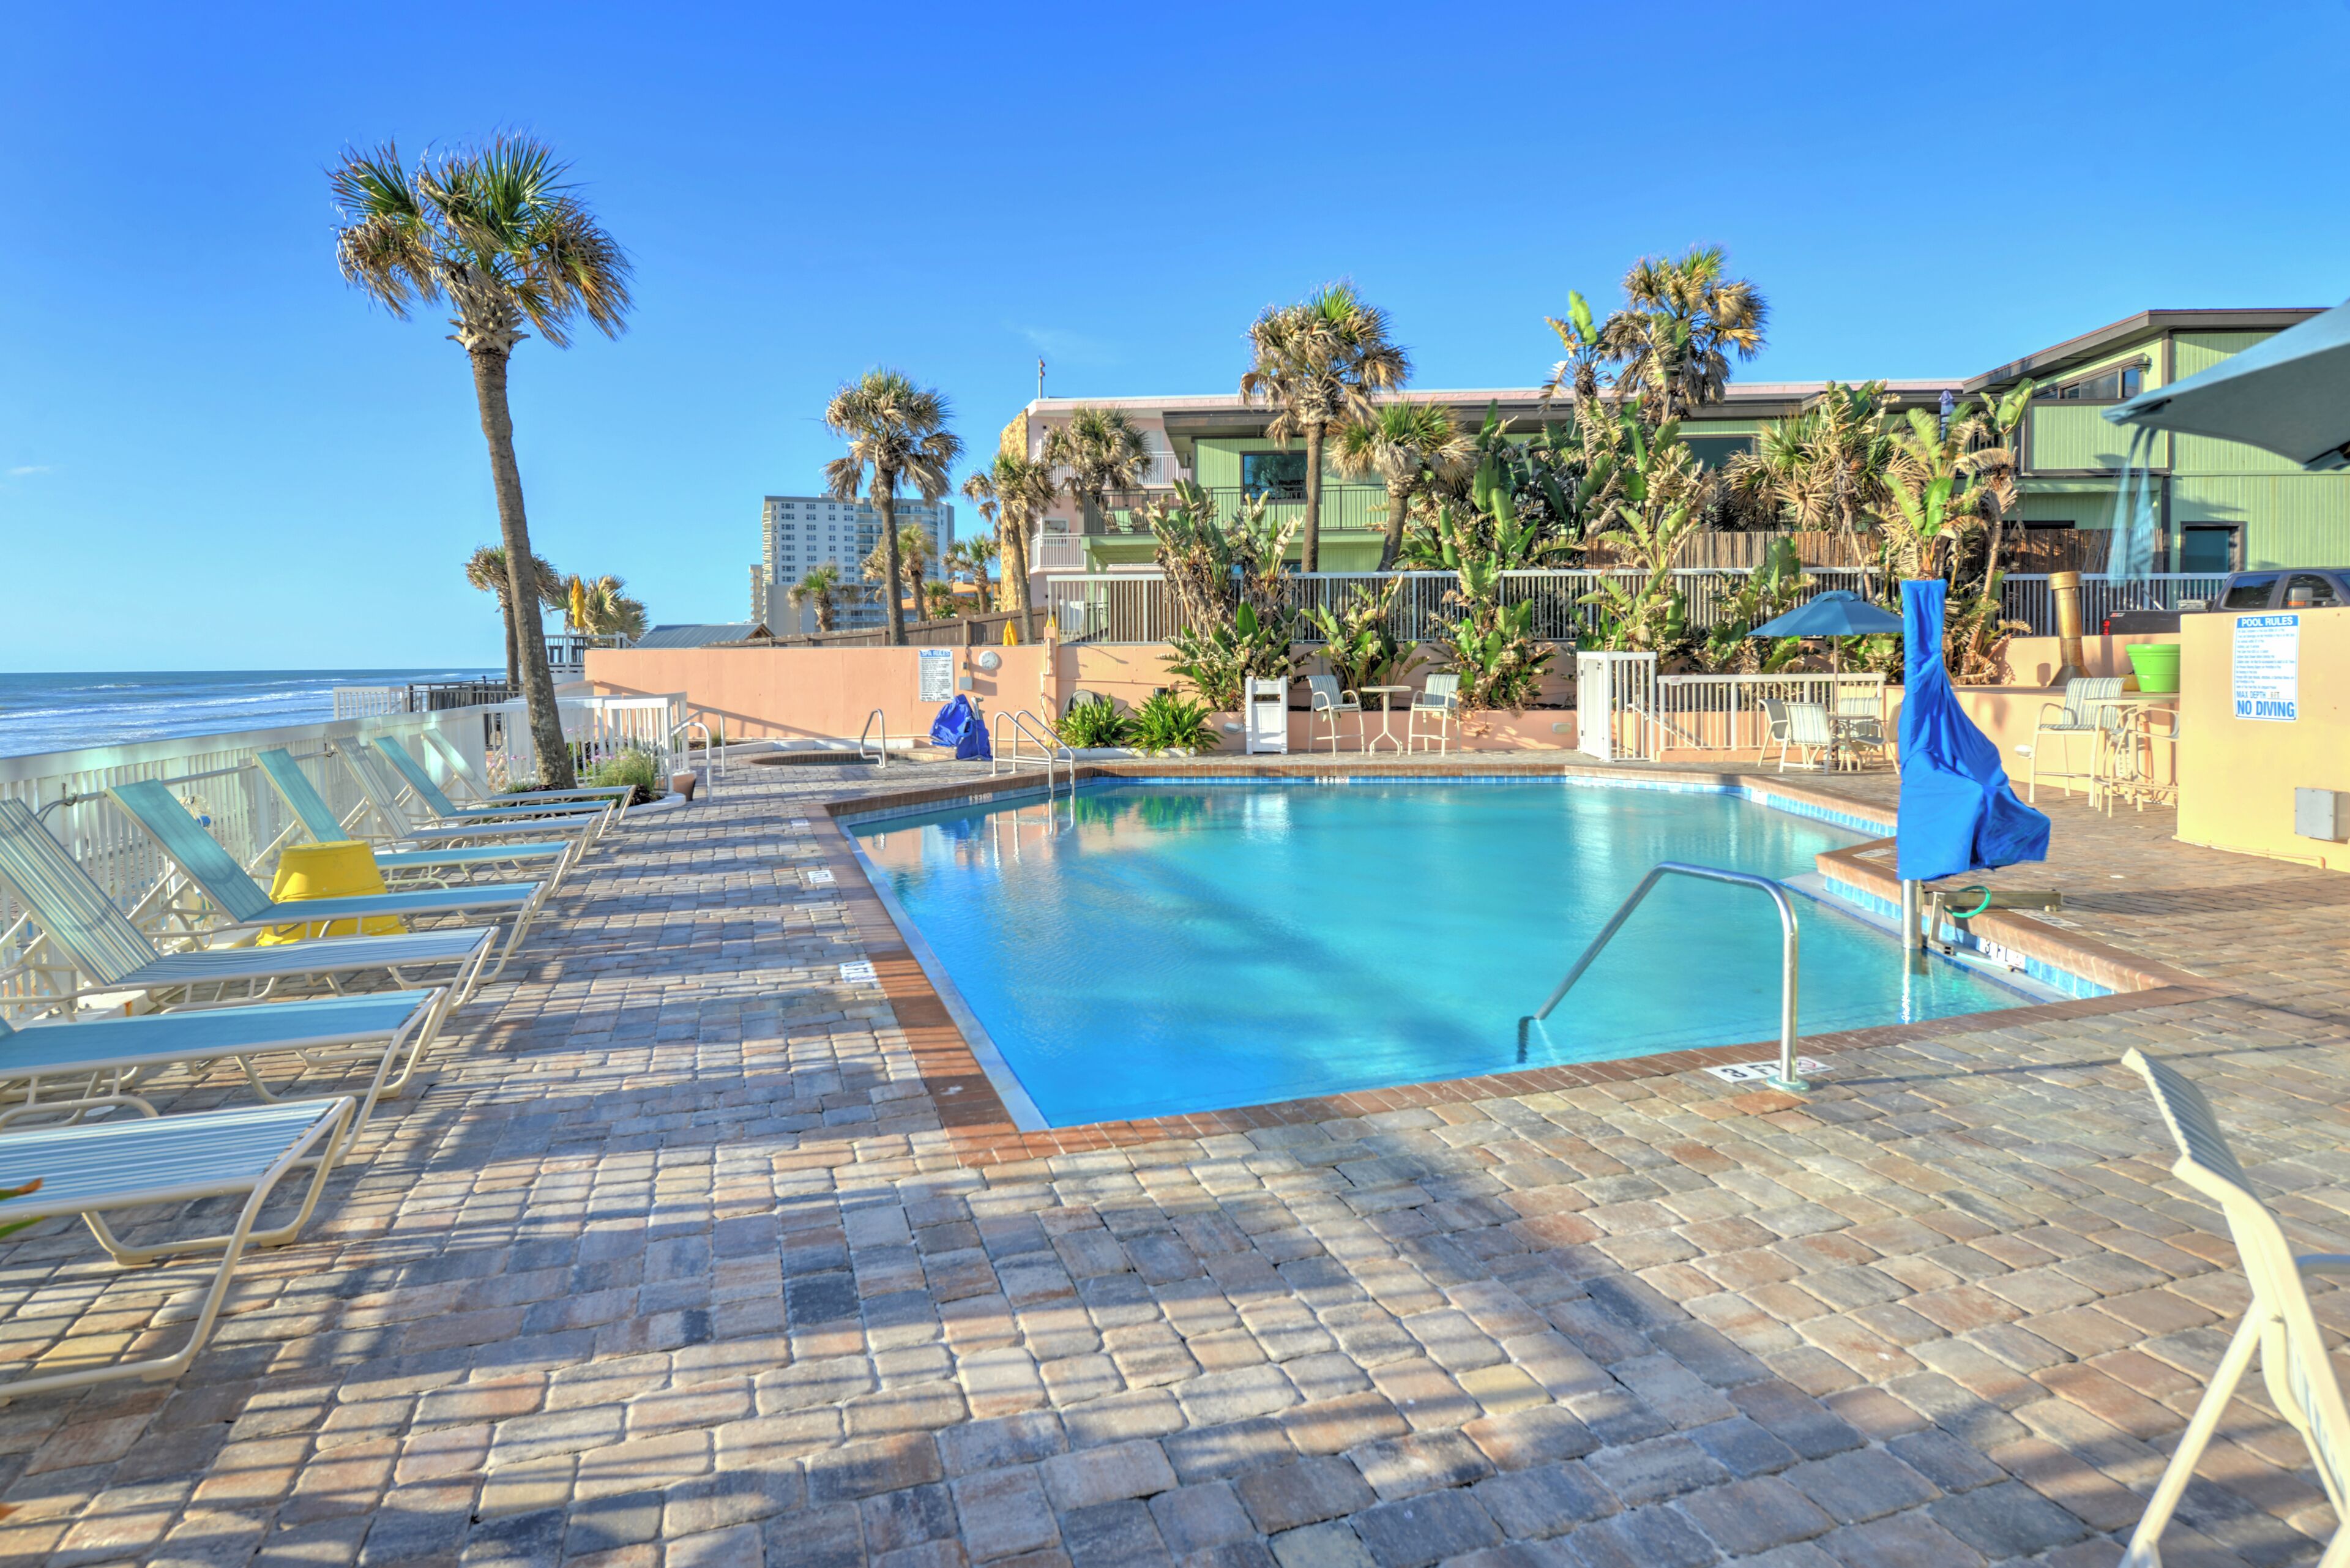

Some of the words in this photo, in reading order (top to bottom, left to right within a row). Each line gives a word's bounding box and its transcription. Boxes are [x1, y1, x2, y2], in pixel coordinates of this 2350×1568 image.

[2242, 618, 2263, 627] POOL
[2265, 616, 2293, 625] RULES
[2237, 700, 2252, 715] NO
[2256, 701, 2294, 717] DIVING
[1985, 939, 1991, 954] 3
[1720, 1068, 1748, 1078] 3
[1746, 1064, 1782, 1075] FT
